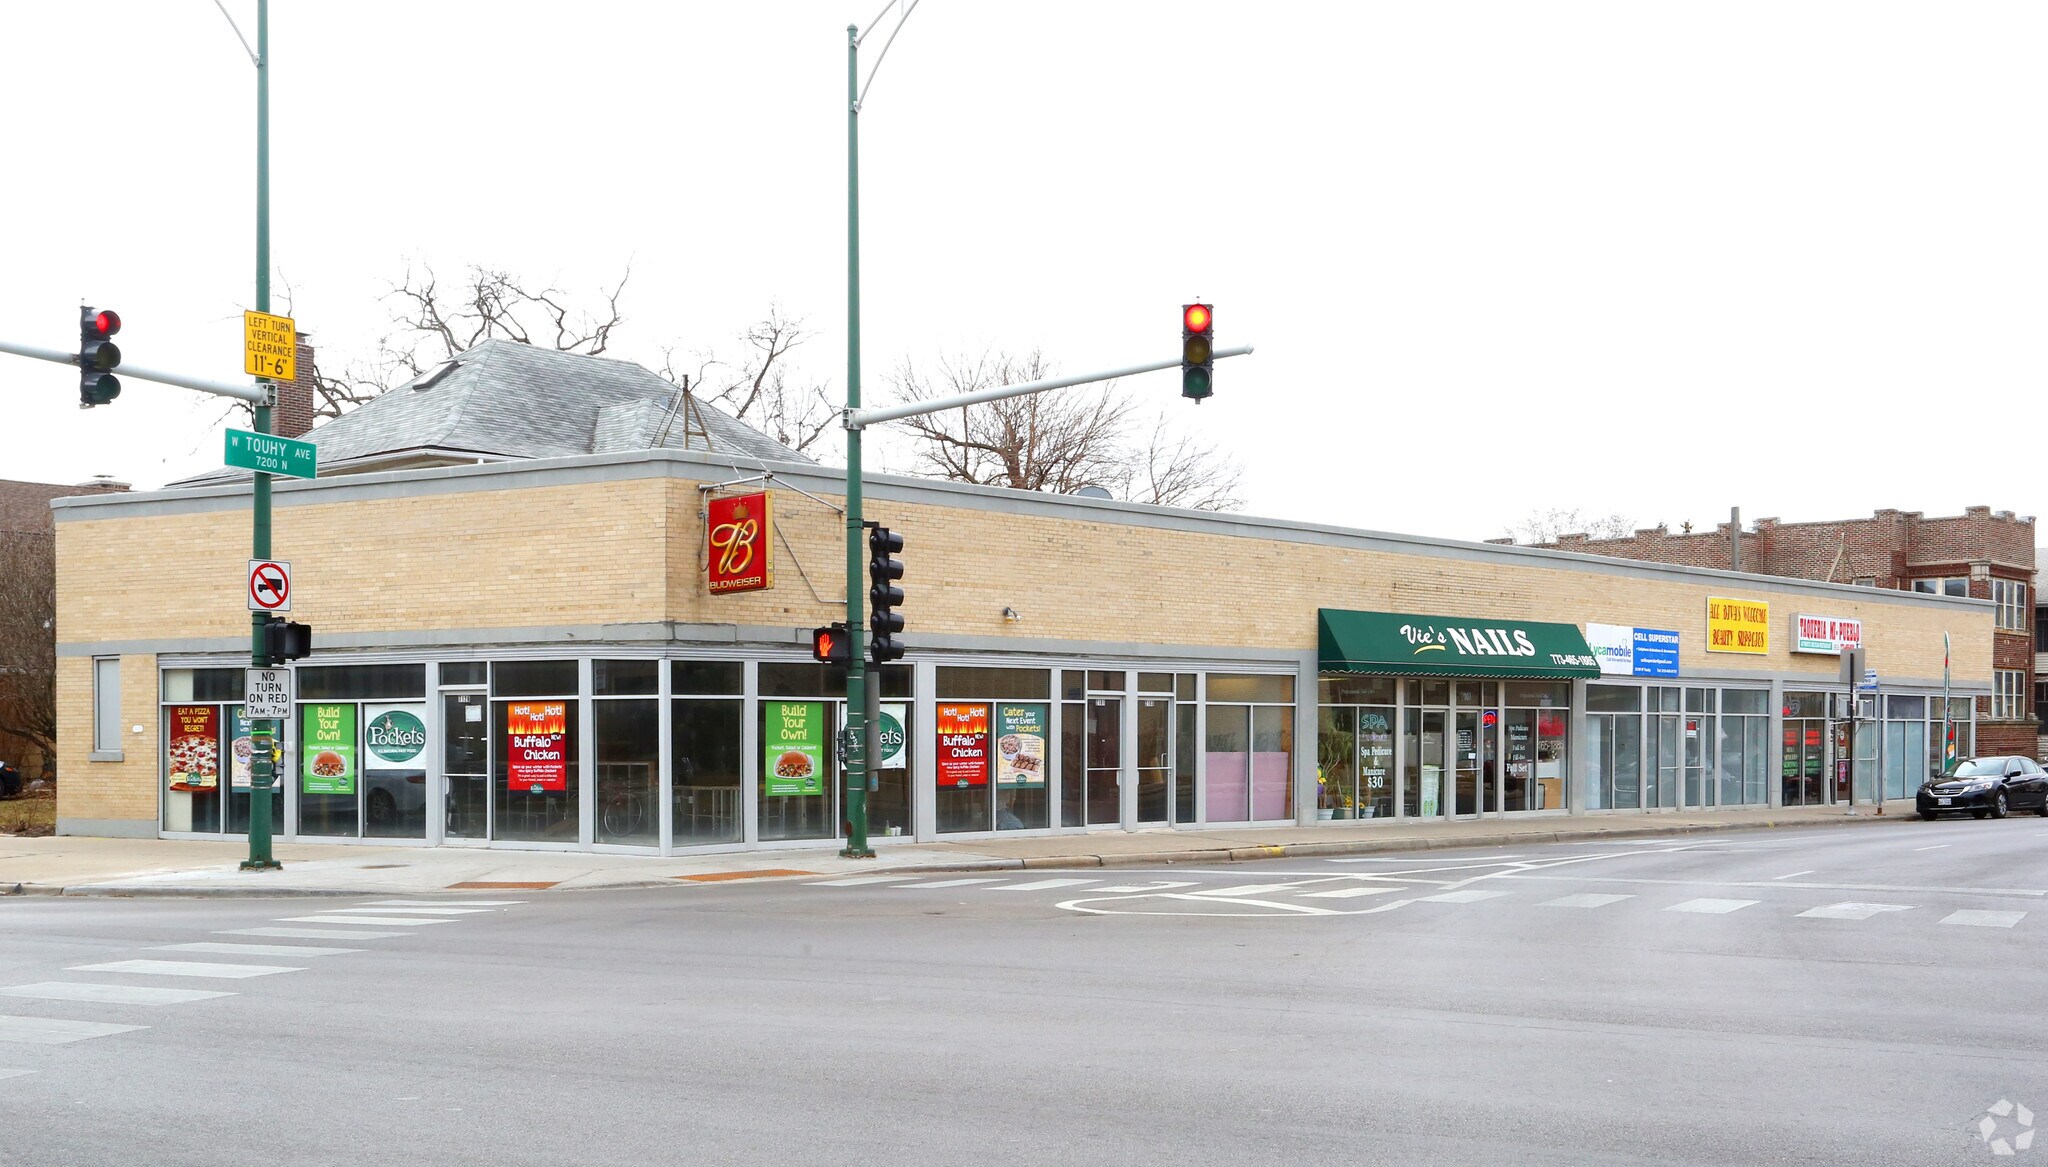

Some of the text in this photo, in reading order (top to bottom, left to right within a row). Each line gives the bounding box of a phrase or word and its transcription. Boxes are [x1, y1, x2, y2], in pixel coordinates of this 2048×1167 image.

[249, 316, 291, 333] LEFT TURN
[252, 329, 287, 345] VERTICAL
[248, 341, 292, 357] CLEARANCE
[232, 437, 310, 459] W TOUHY AVE
[256, 456, 288, 470] 7200 N
[710, 576, 761, 590] BUDWEISER
[1800, 618, 1826, 639] TAQUERIA
[1839, 623, 1860, 641] PUEBLO
[1446, 627, 1535, 656] NAILS
[1633, 632, 1679, 644] CELL SUPERSTAR
[1713, 629, 1764, 647] BEAUTY SUPPLIES
[262, 672, 275, 682] NO
[255, 683, 282, 692] TURN
[249, 694, 287, 703] ON RED
[249, 706, 265, 714] 7AM
[272, 706, 287, 714] 7PM
[318, 707, 340, 718] Build
[514, 706, 530, 715] Hot!
[545, 705, 562, 715] Hot!
[782, 705, 806, 716] Build
[970, 708, 985, 717] Hot!
[1003, 707, 1025, 716] Cater
[319, 718, 339, 729] Your
[783, 717, 805, 728] Your
[1360, 714, 1388, 730] SPA
[1483, 715, 1497, 724] PEN
[317, 730, 340, 741] Own!
[370, 726, 424, 746] Pockets
[781, 729, 806, 740] Own!
[514, 736, 551, 748] Buffalo
[943, 735, 975, 746] Buffalo
[524, 750, 560, 760] Chicken
[951, 748, 983, 758] Chicken
[1361, 746, 1392, 759] Spa Pedicure
[1373, 757, 1379, 765] &
[1363, 767, 1385, 776] Manicure
[1506, 764, 1528, 773] Full Set
[1367, 776, 1383, 788] $30
